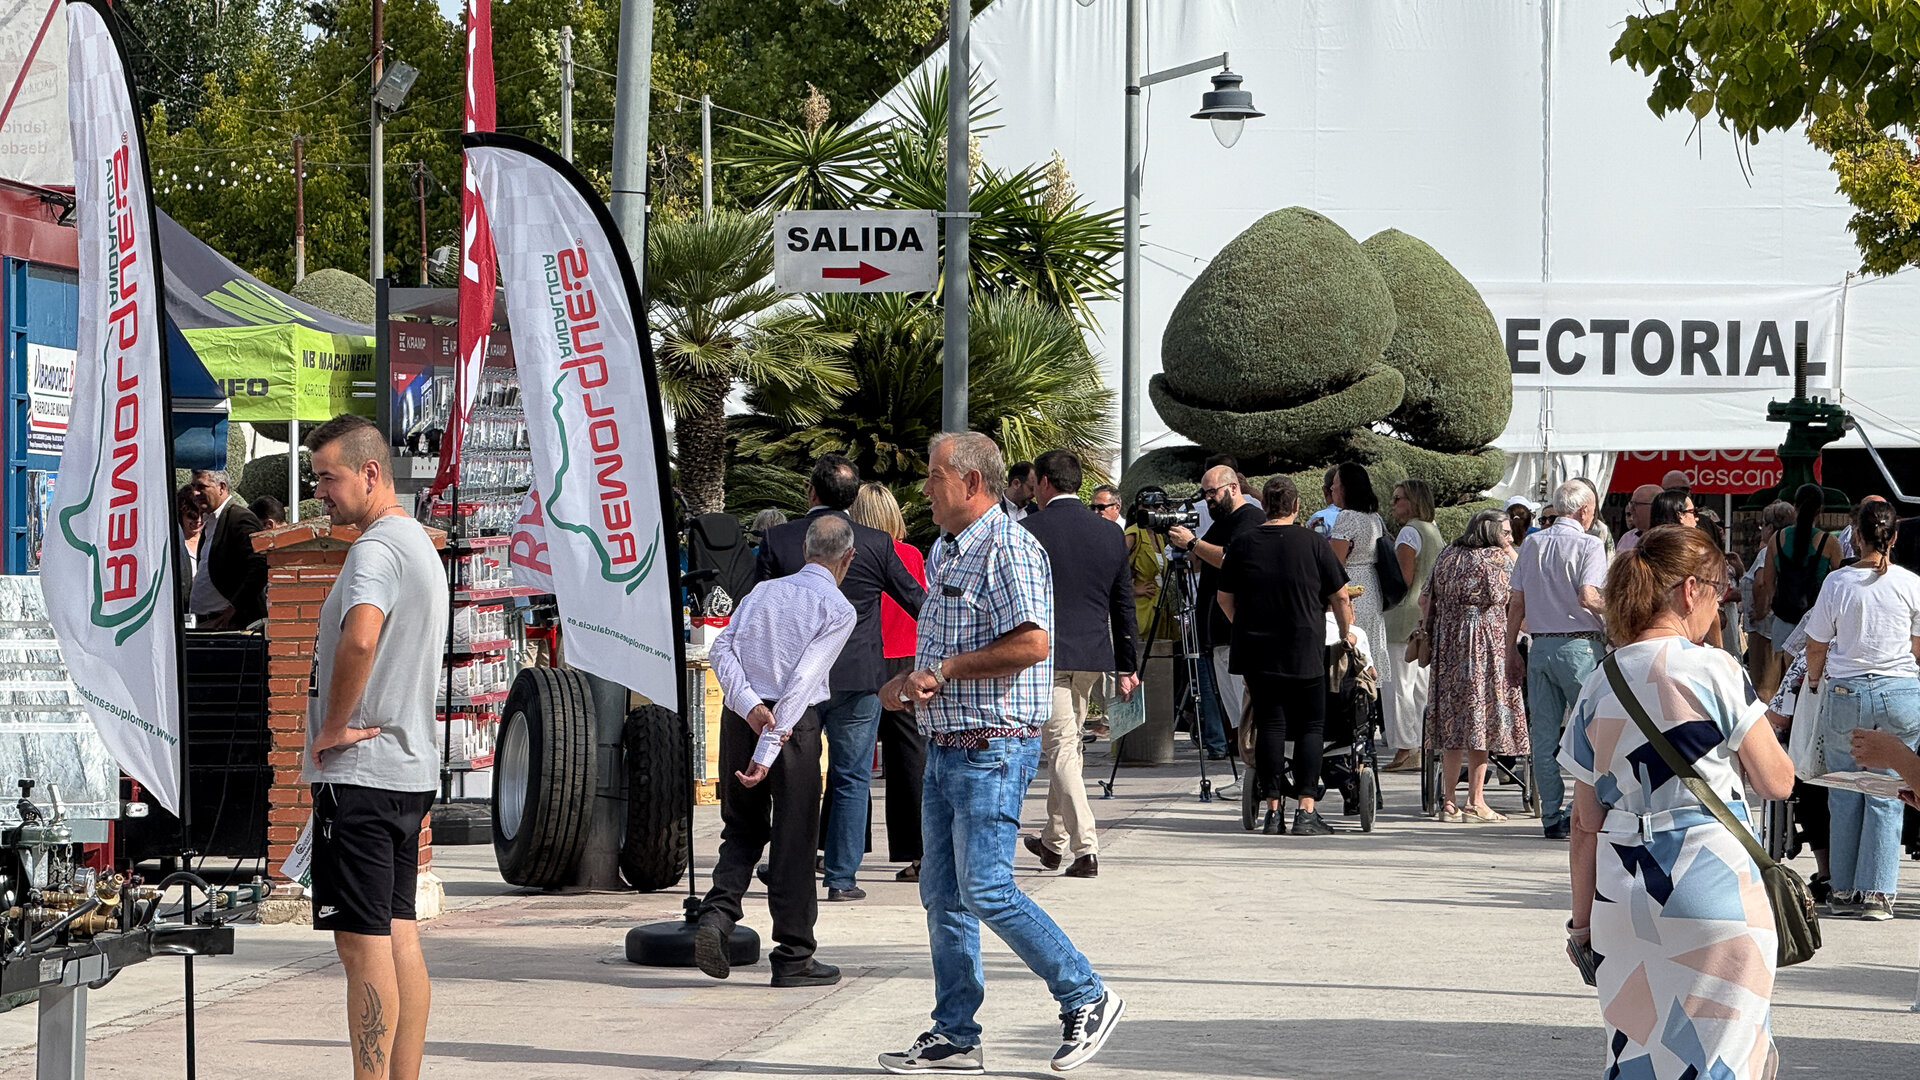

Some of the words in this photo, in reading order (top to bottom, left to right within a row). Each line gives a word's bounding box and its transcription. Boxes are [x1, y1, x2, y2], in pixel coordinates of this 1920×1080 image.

[787, 226, 924, 253] SALIDA
[406, 336, 427, 350] KRAMP
[490, 344, 508, 357] KRAMP
[1506, 317, 1827, 377] ECTORIAL
[34, 349, 69, 393] VIBRADORES
[302, 350, 316, 369] NB
[318, 351, 373, 372] MACHINERY
[34, 399, 49, 415] FABRICA
[50, 402, 56, 416] DE
[1683, 464, 1784, 487] descans
